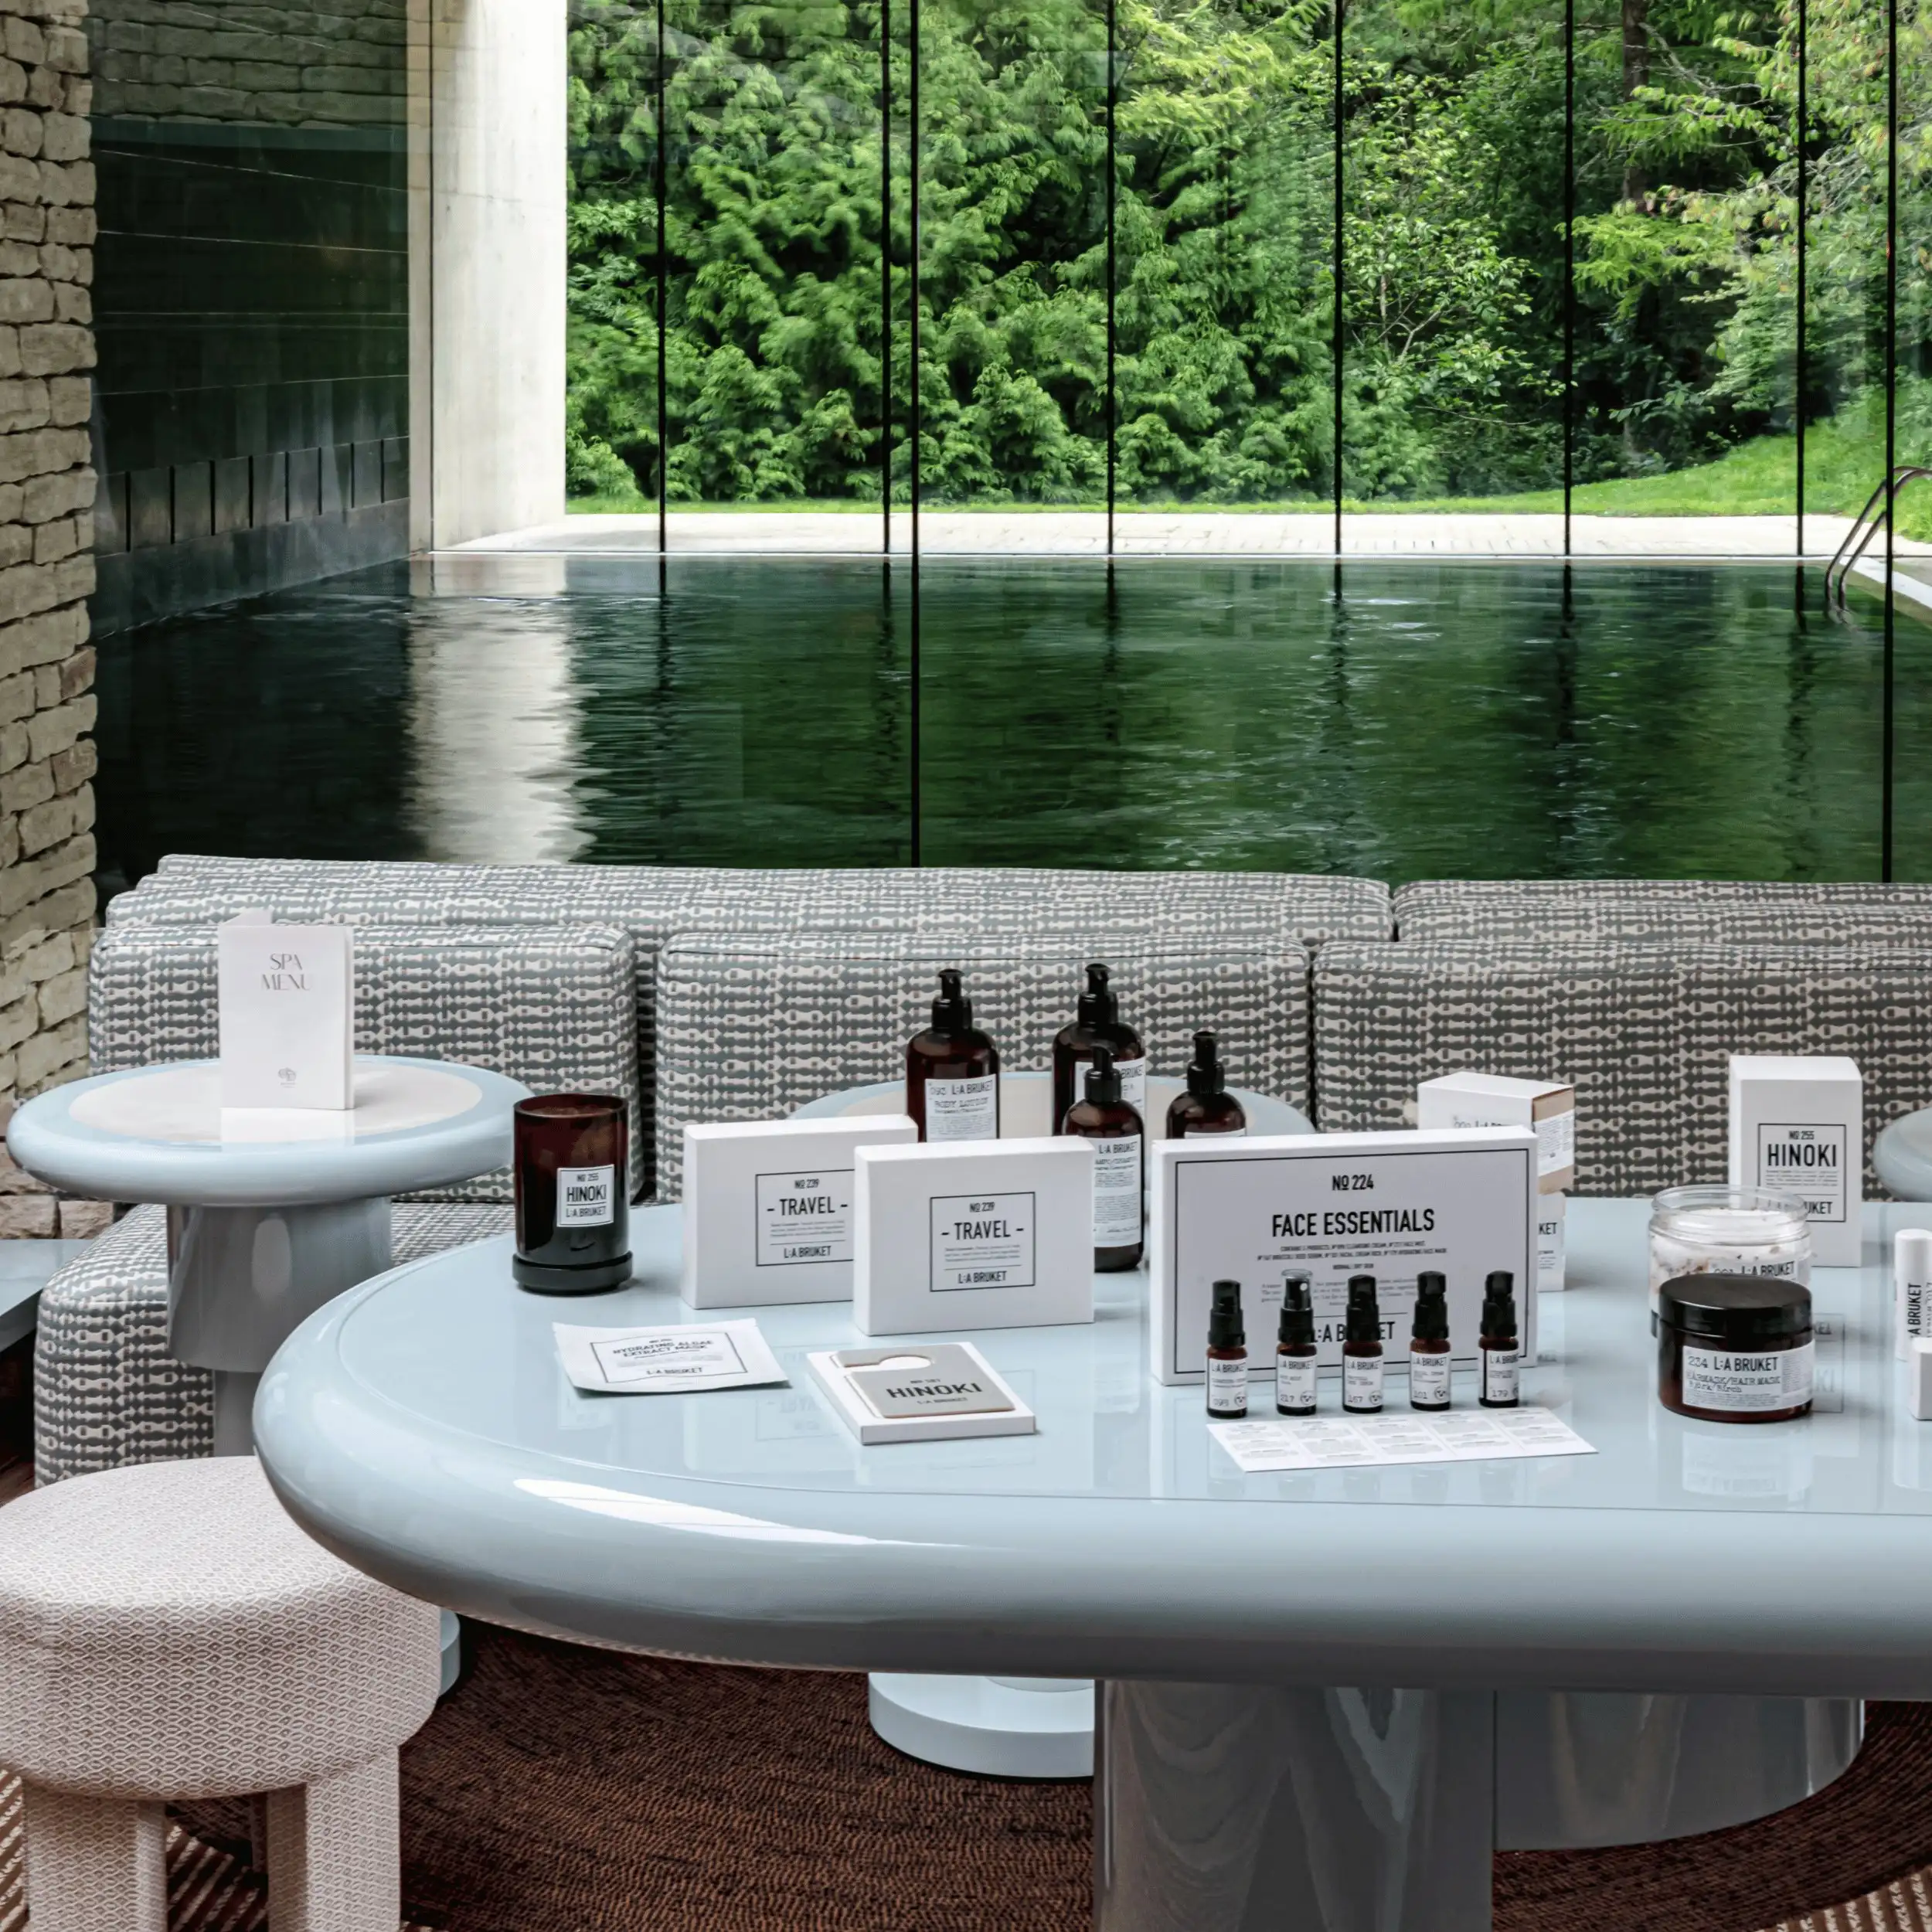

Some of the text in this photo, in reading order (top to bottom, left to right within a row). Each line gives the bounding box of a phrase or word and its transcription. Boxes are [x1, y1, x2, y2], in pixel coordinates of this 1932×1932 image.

[270, 952, 302, 971] SPA
[261, 973, 313, 991] MENU
[1767, 1144, 1836, 1167] HINOKI
[1352, 1174, 1374, 1191] 224
[566, 1184, 607, 1202] HINOKI
[579, 1206, 607, 1218] BRUKET
[779, 1196, 835, 1216] TRAVEL
[954, 1219, 1011, 1240] TRAVEL
[1272, 1208, 1435, 1237] FACE ESSENTIALS
[798, 1245, 832, 1257] BRUKET
[973, 1270, 1007, 1283] BRUKET
[1907, 1282, 1922, 1325] BRUKET
[1688, 1355, 1779, 1372] 234 L:A BRUKET
[886, 1382, 983, 1398] HINOKI
